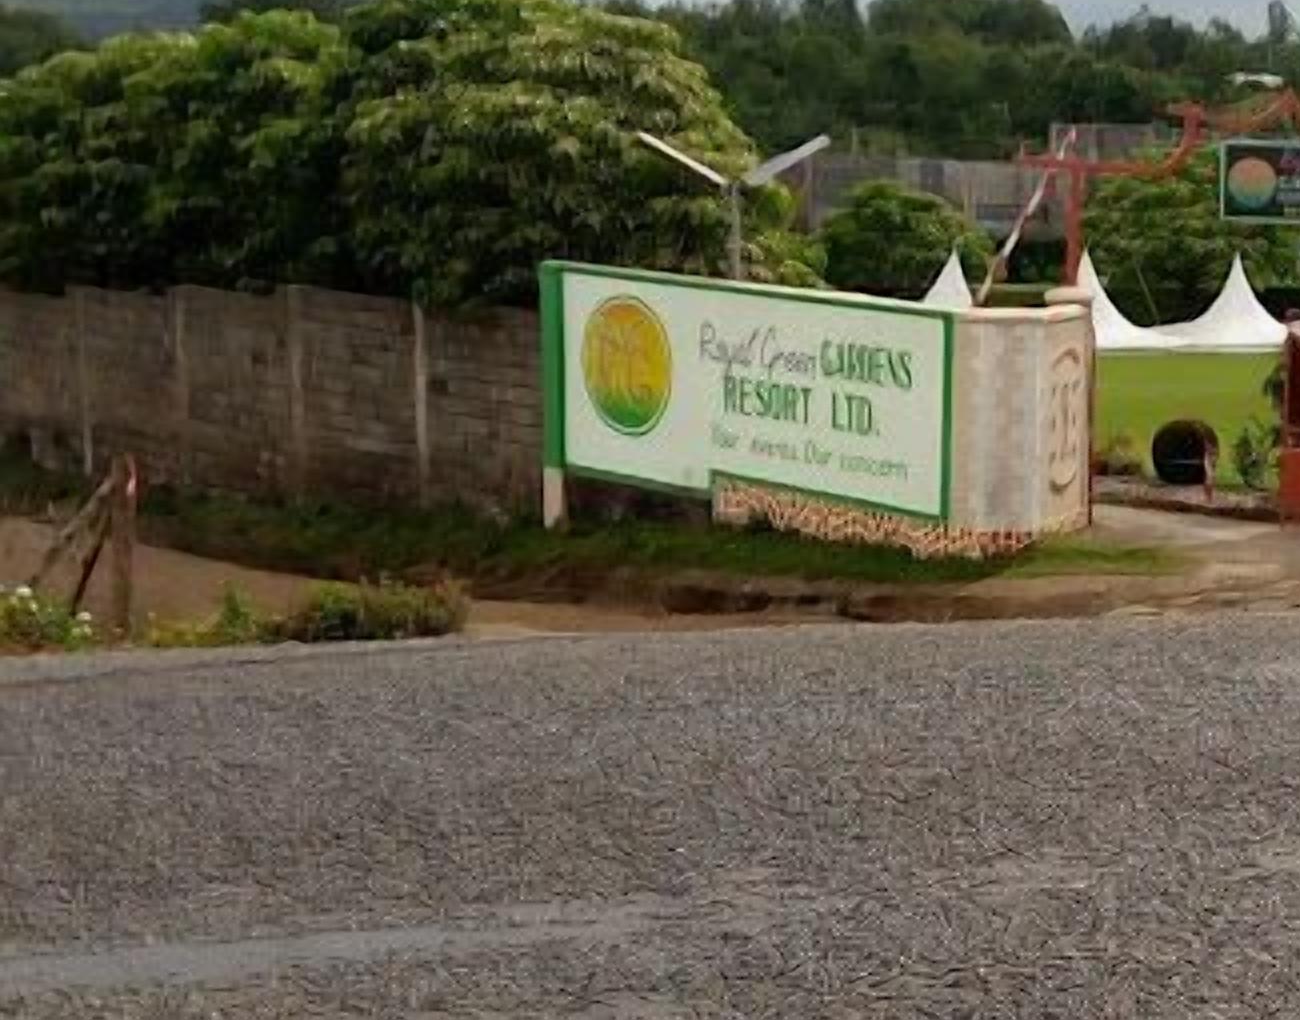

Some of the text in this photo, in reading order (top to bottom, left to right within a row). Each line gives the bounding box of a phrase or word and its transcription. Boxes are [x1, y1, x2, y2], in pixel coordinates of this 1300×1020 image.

[820, 339, 913, 391] GARDENS
[723, 374, 880, 436] RESORT LTD.
